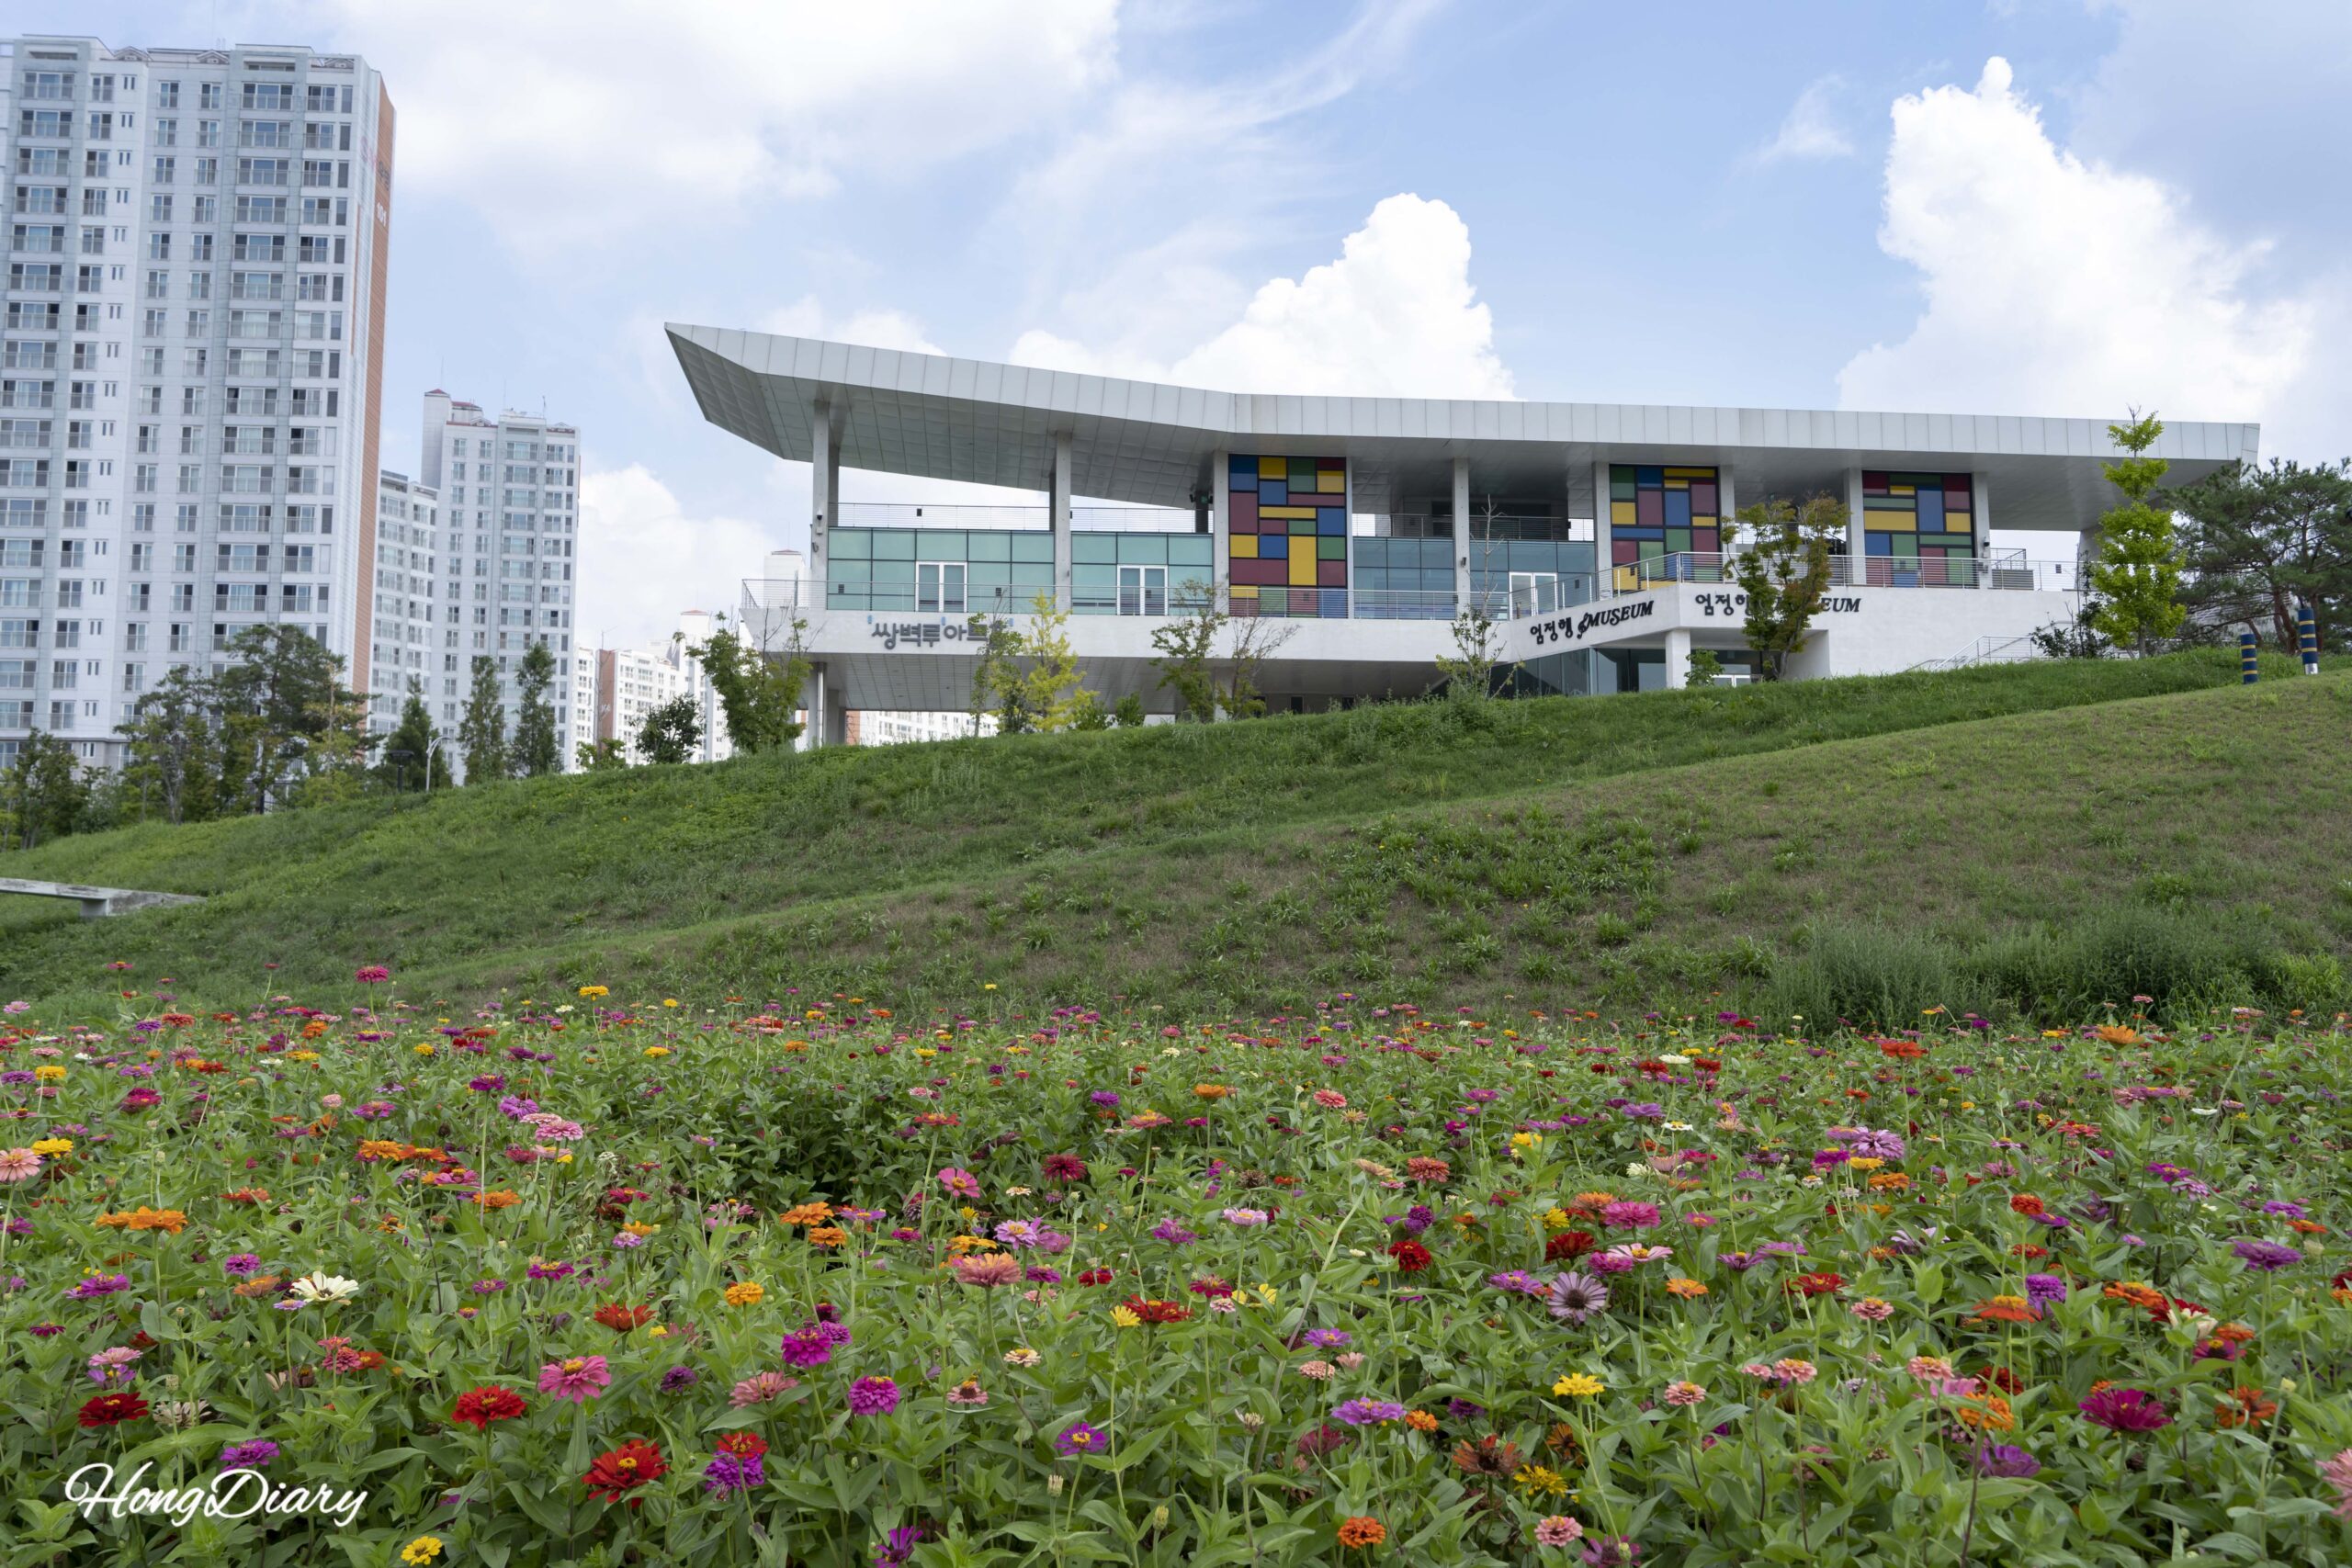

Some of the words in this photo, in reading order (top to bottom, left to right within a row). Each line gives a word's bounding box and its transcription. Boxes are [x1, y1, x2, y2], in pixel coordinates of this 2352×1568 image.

[872, 621, 1007, 650] 쌍벽루아트
[1530, 616, 1574, 645] 엄정행
[1584, 600, 1655, 630] MUSEUM
